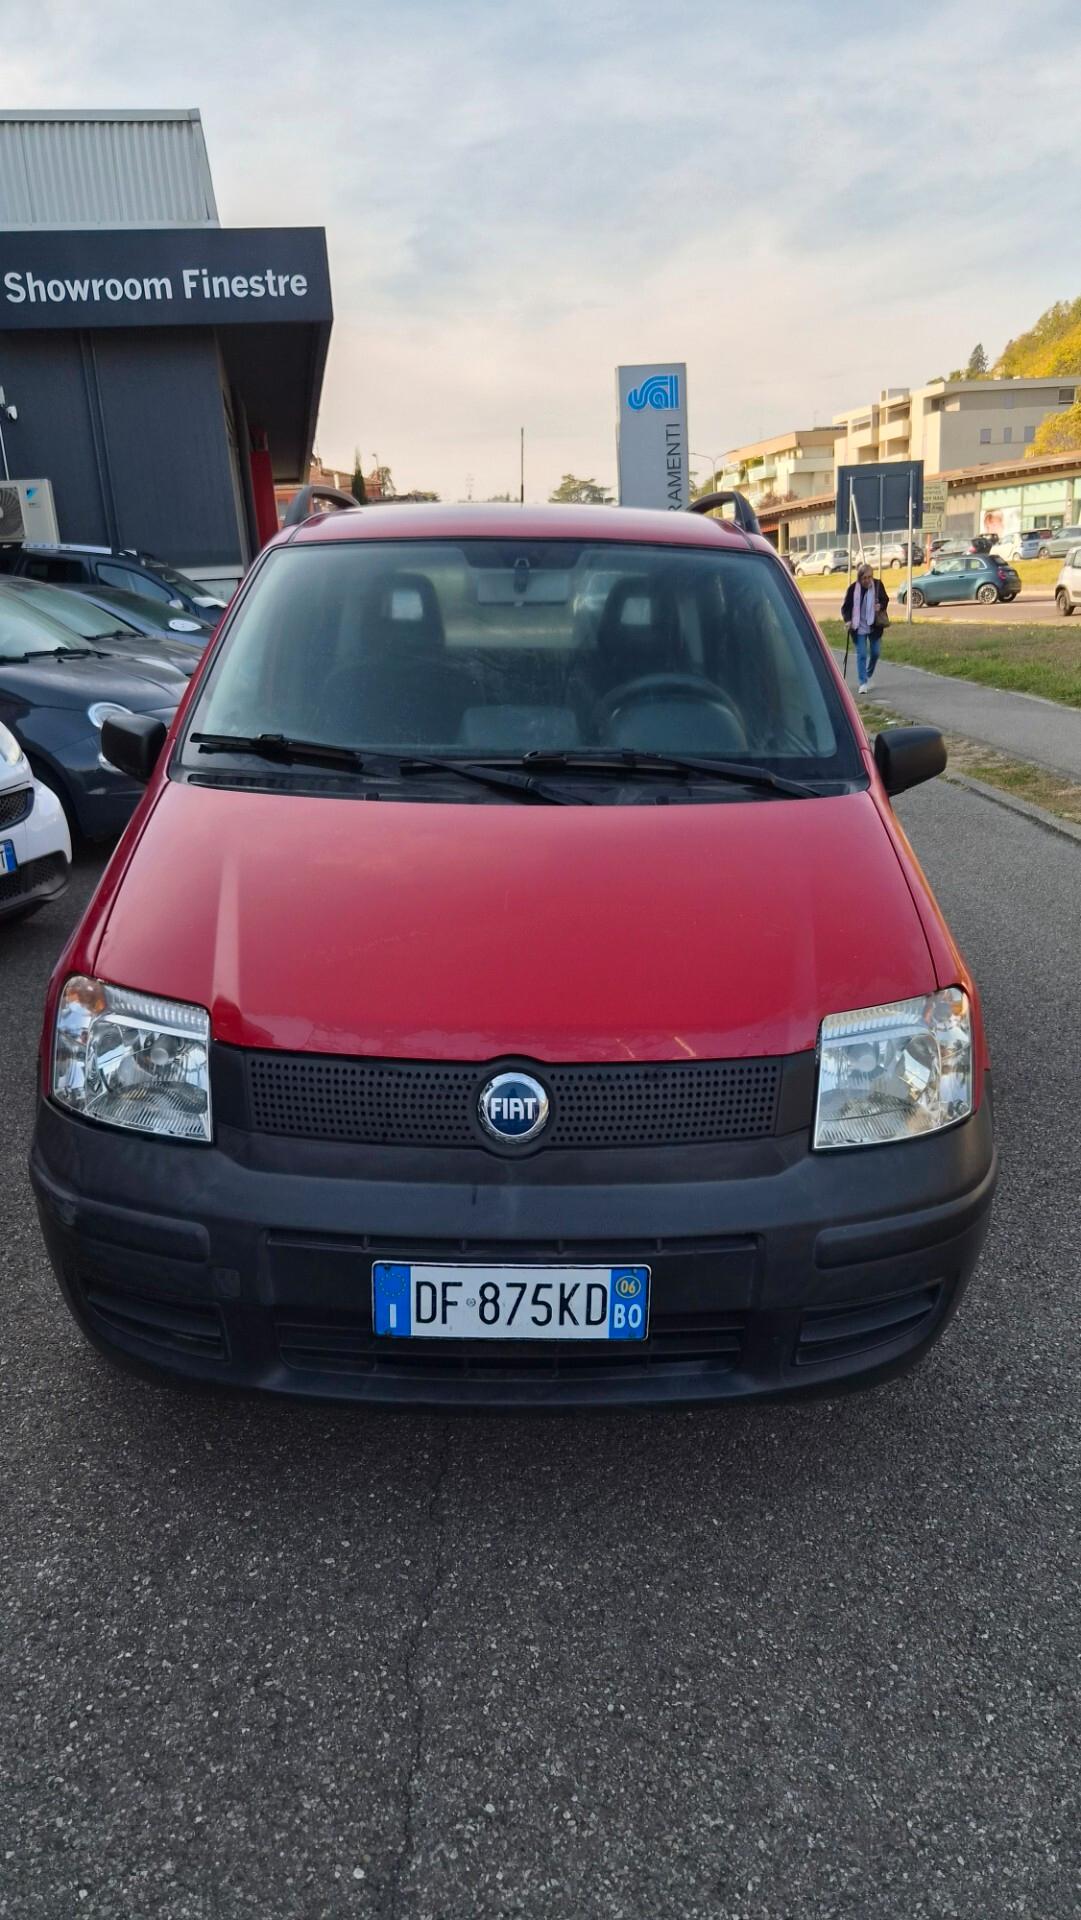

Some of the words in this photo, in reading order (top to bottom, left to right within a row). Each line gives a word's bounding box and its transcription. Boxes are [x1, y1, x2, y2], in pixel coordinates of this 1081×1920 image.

[4, 271, 173, 303] Showroom
[182, 268, 308, 299] Finestre
[490, 1097, 537, 1120] FIAT
[620, 1279, 636, 1294] 06
[415, 1281, 463, 1325] DF
[478, 1282, 608, 1327] 875KD
[613, 1303, 643, 1329] BO
